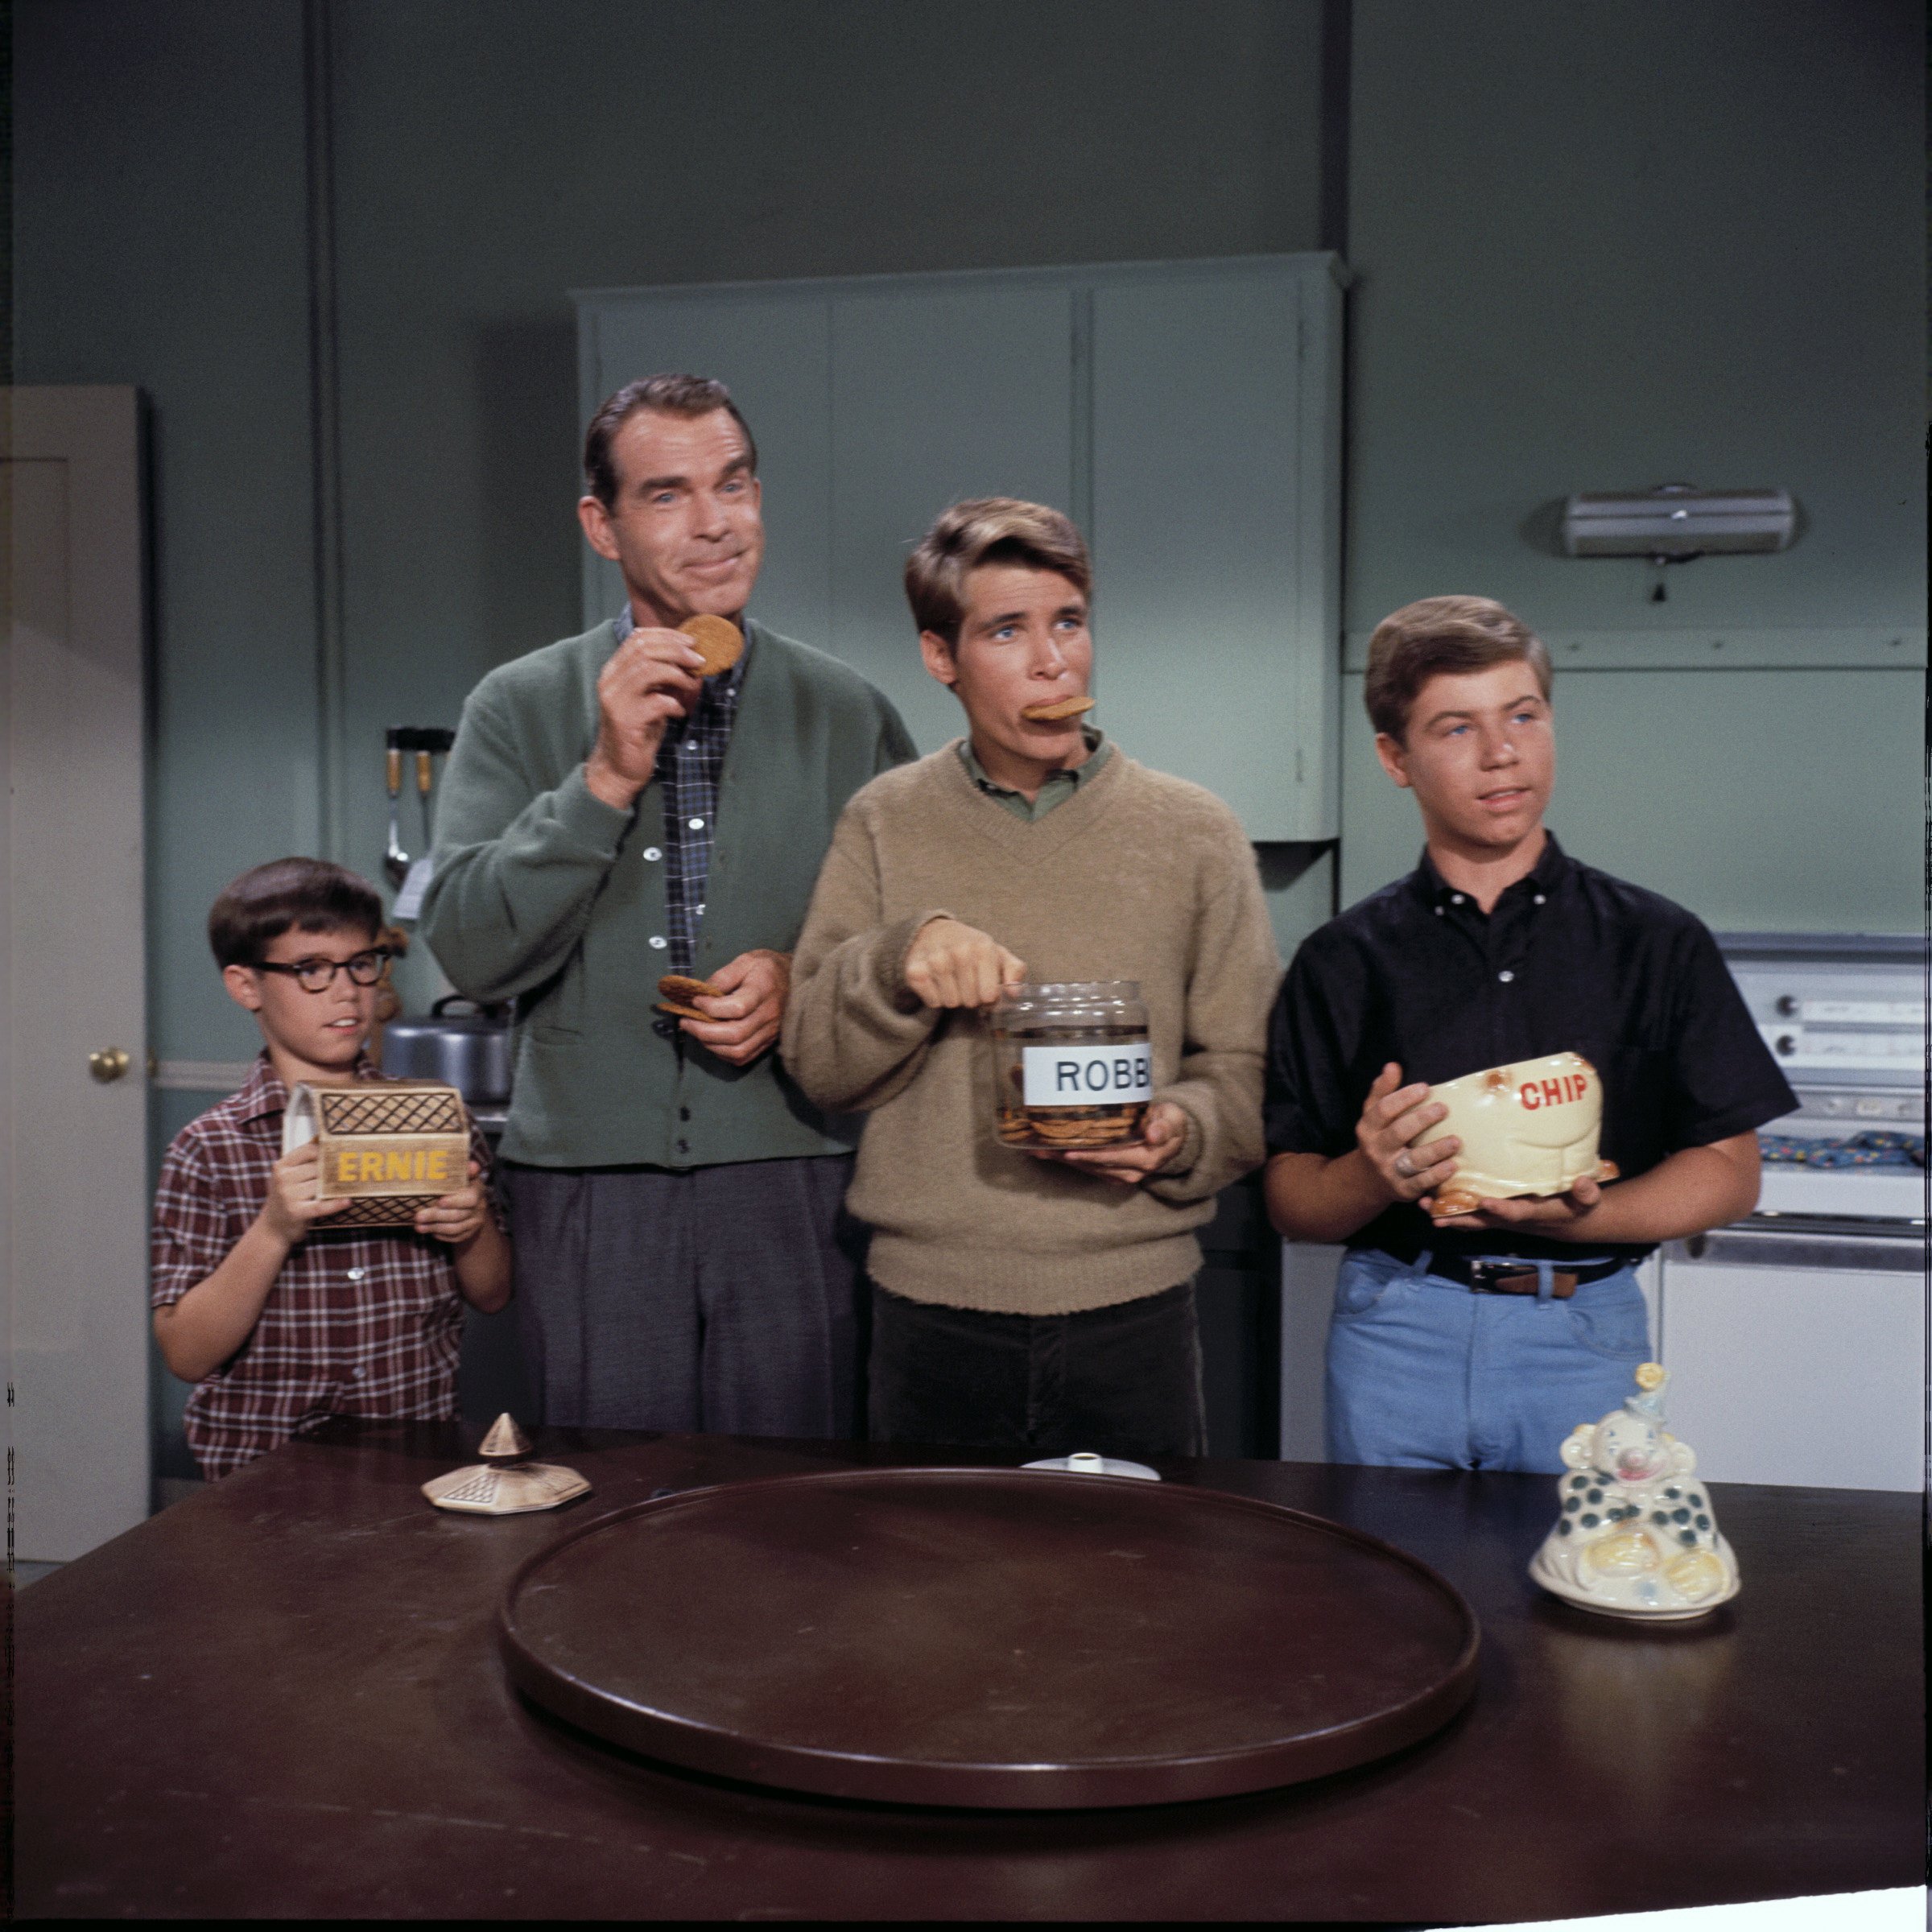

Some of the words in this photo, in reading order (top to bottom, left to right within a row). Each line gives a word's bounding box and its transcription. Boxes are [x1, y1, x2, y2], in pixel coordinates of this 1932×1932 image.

[1055, 1058, 1150, 1092] ROBB
[1520, 1074, 1587, 1110] CHIP
[338, 1150, 448, 1182] ERNIE
